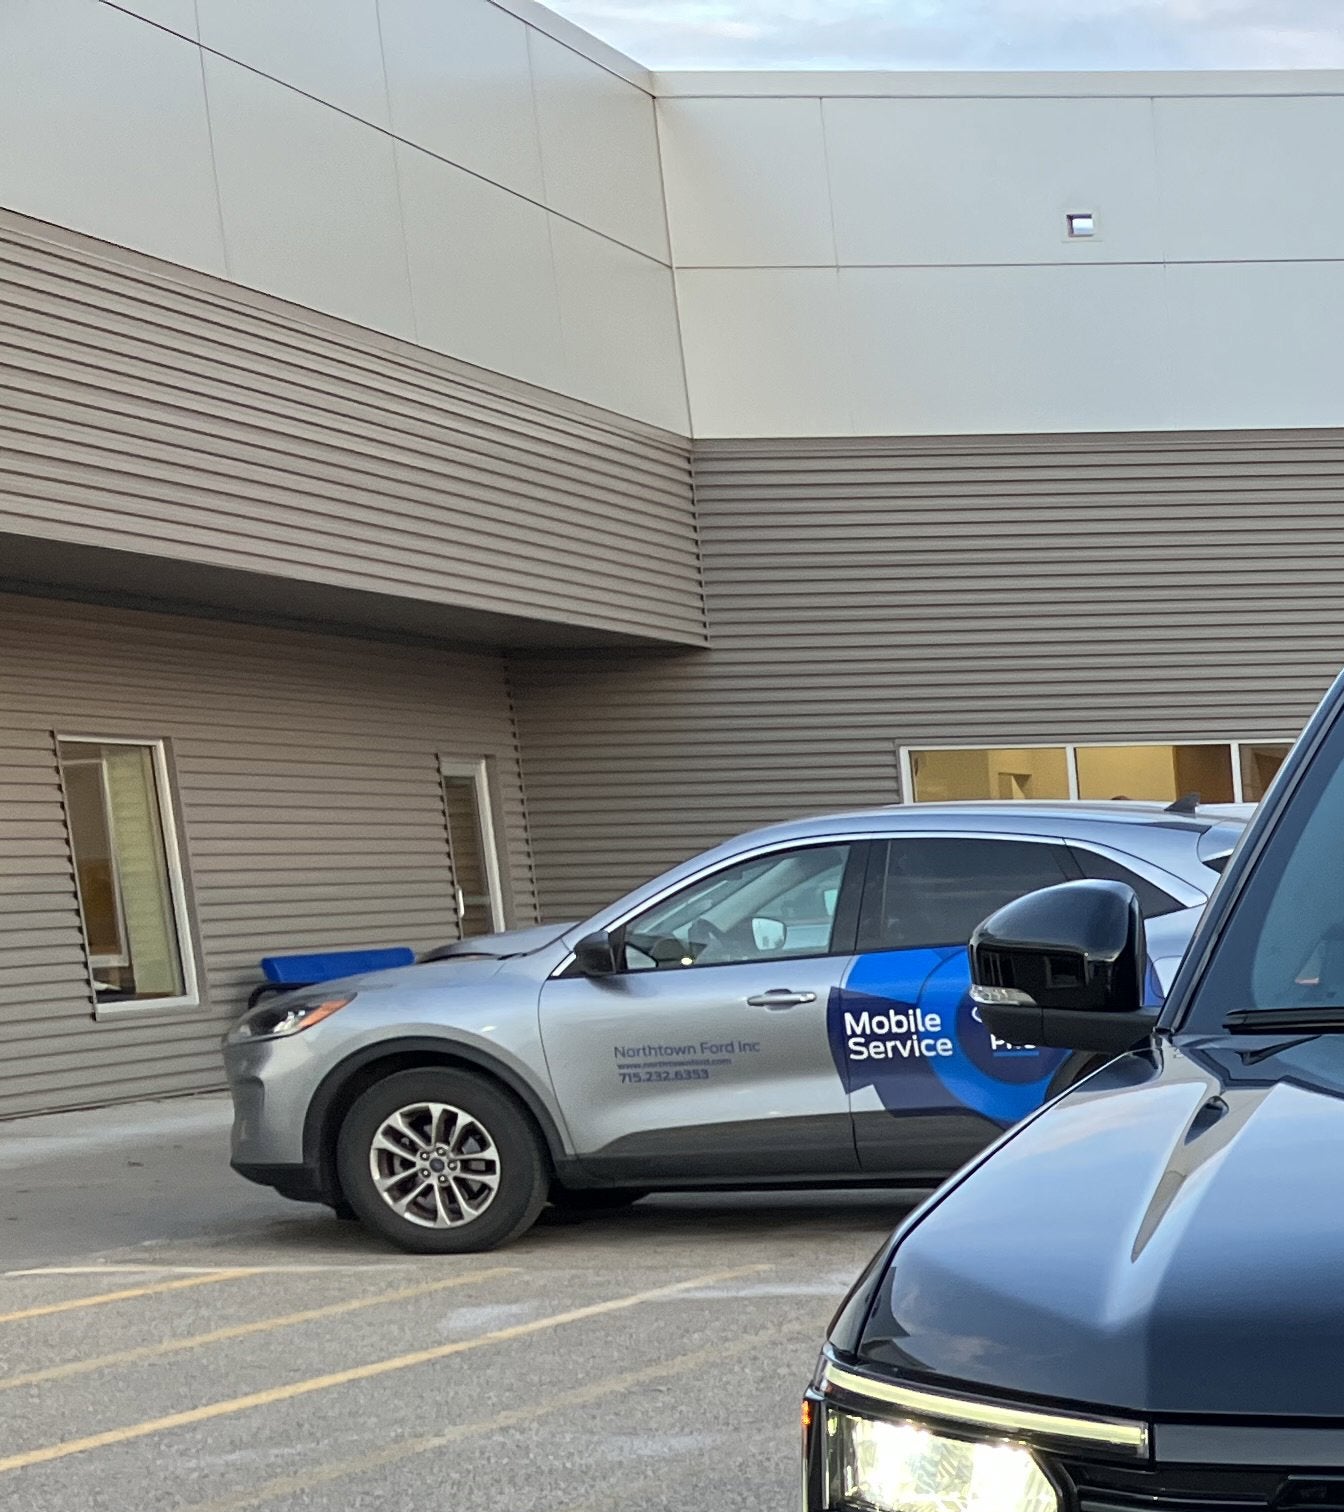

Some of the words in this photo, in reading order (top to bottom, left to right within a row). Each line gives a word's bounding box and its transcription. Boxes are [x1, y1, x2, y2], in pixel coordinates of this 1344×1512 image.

[843, 1008, 942, 1036] Mobile
[614, 1044, 697, 1059] Northtown
[700, 1041, 734, 1055] Ford
[738, 1040, 761, 1054] Inc
[848, 1035, 953, 1060] Service
